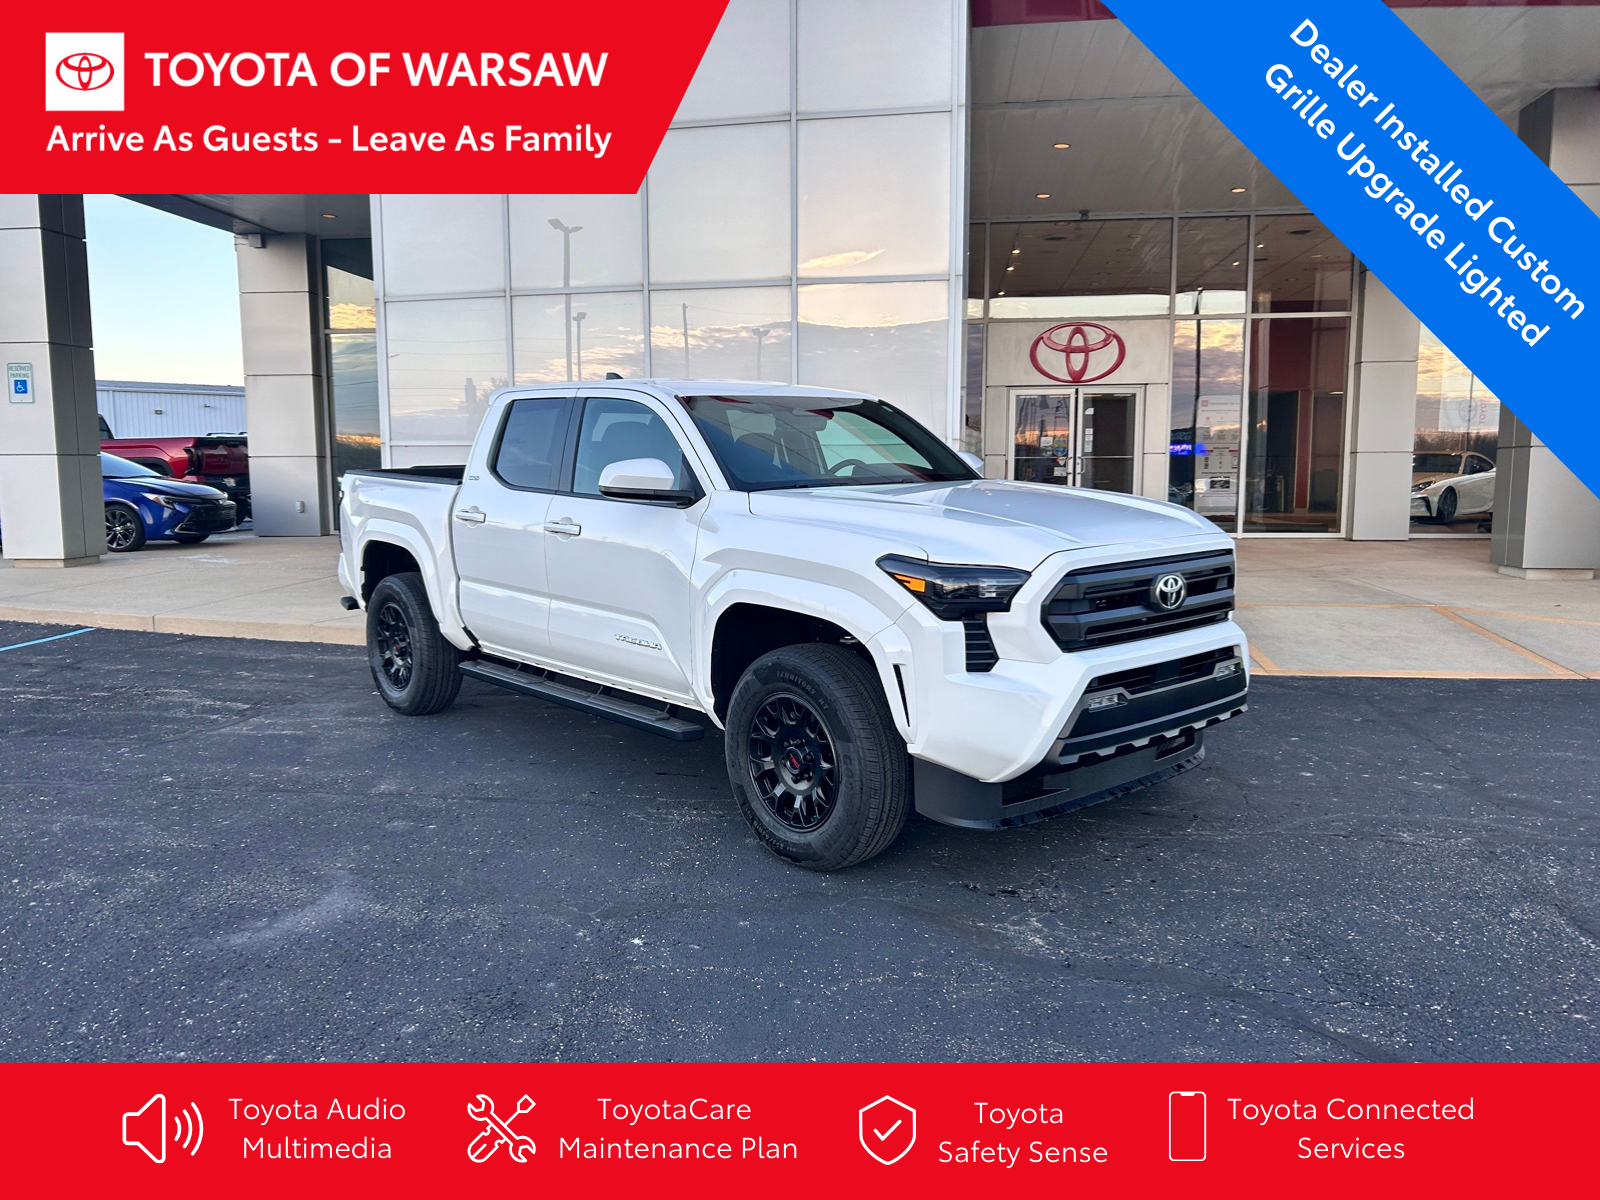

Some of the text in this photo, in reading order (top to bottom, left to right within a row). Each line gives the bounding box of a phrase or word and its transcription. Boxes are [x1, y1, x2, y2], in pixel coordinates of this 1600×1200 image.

[1479, 396, 1487, 425] TOYOT
[614, 634, 662, 651] TACOMA
[776, 671, 817, 695] TERRITORY
